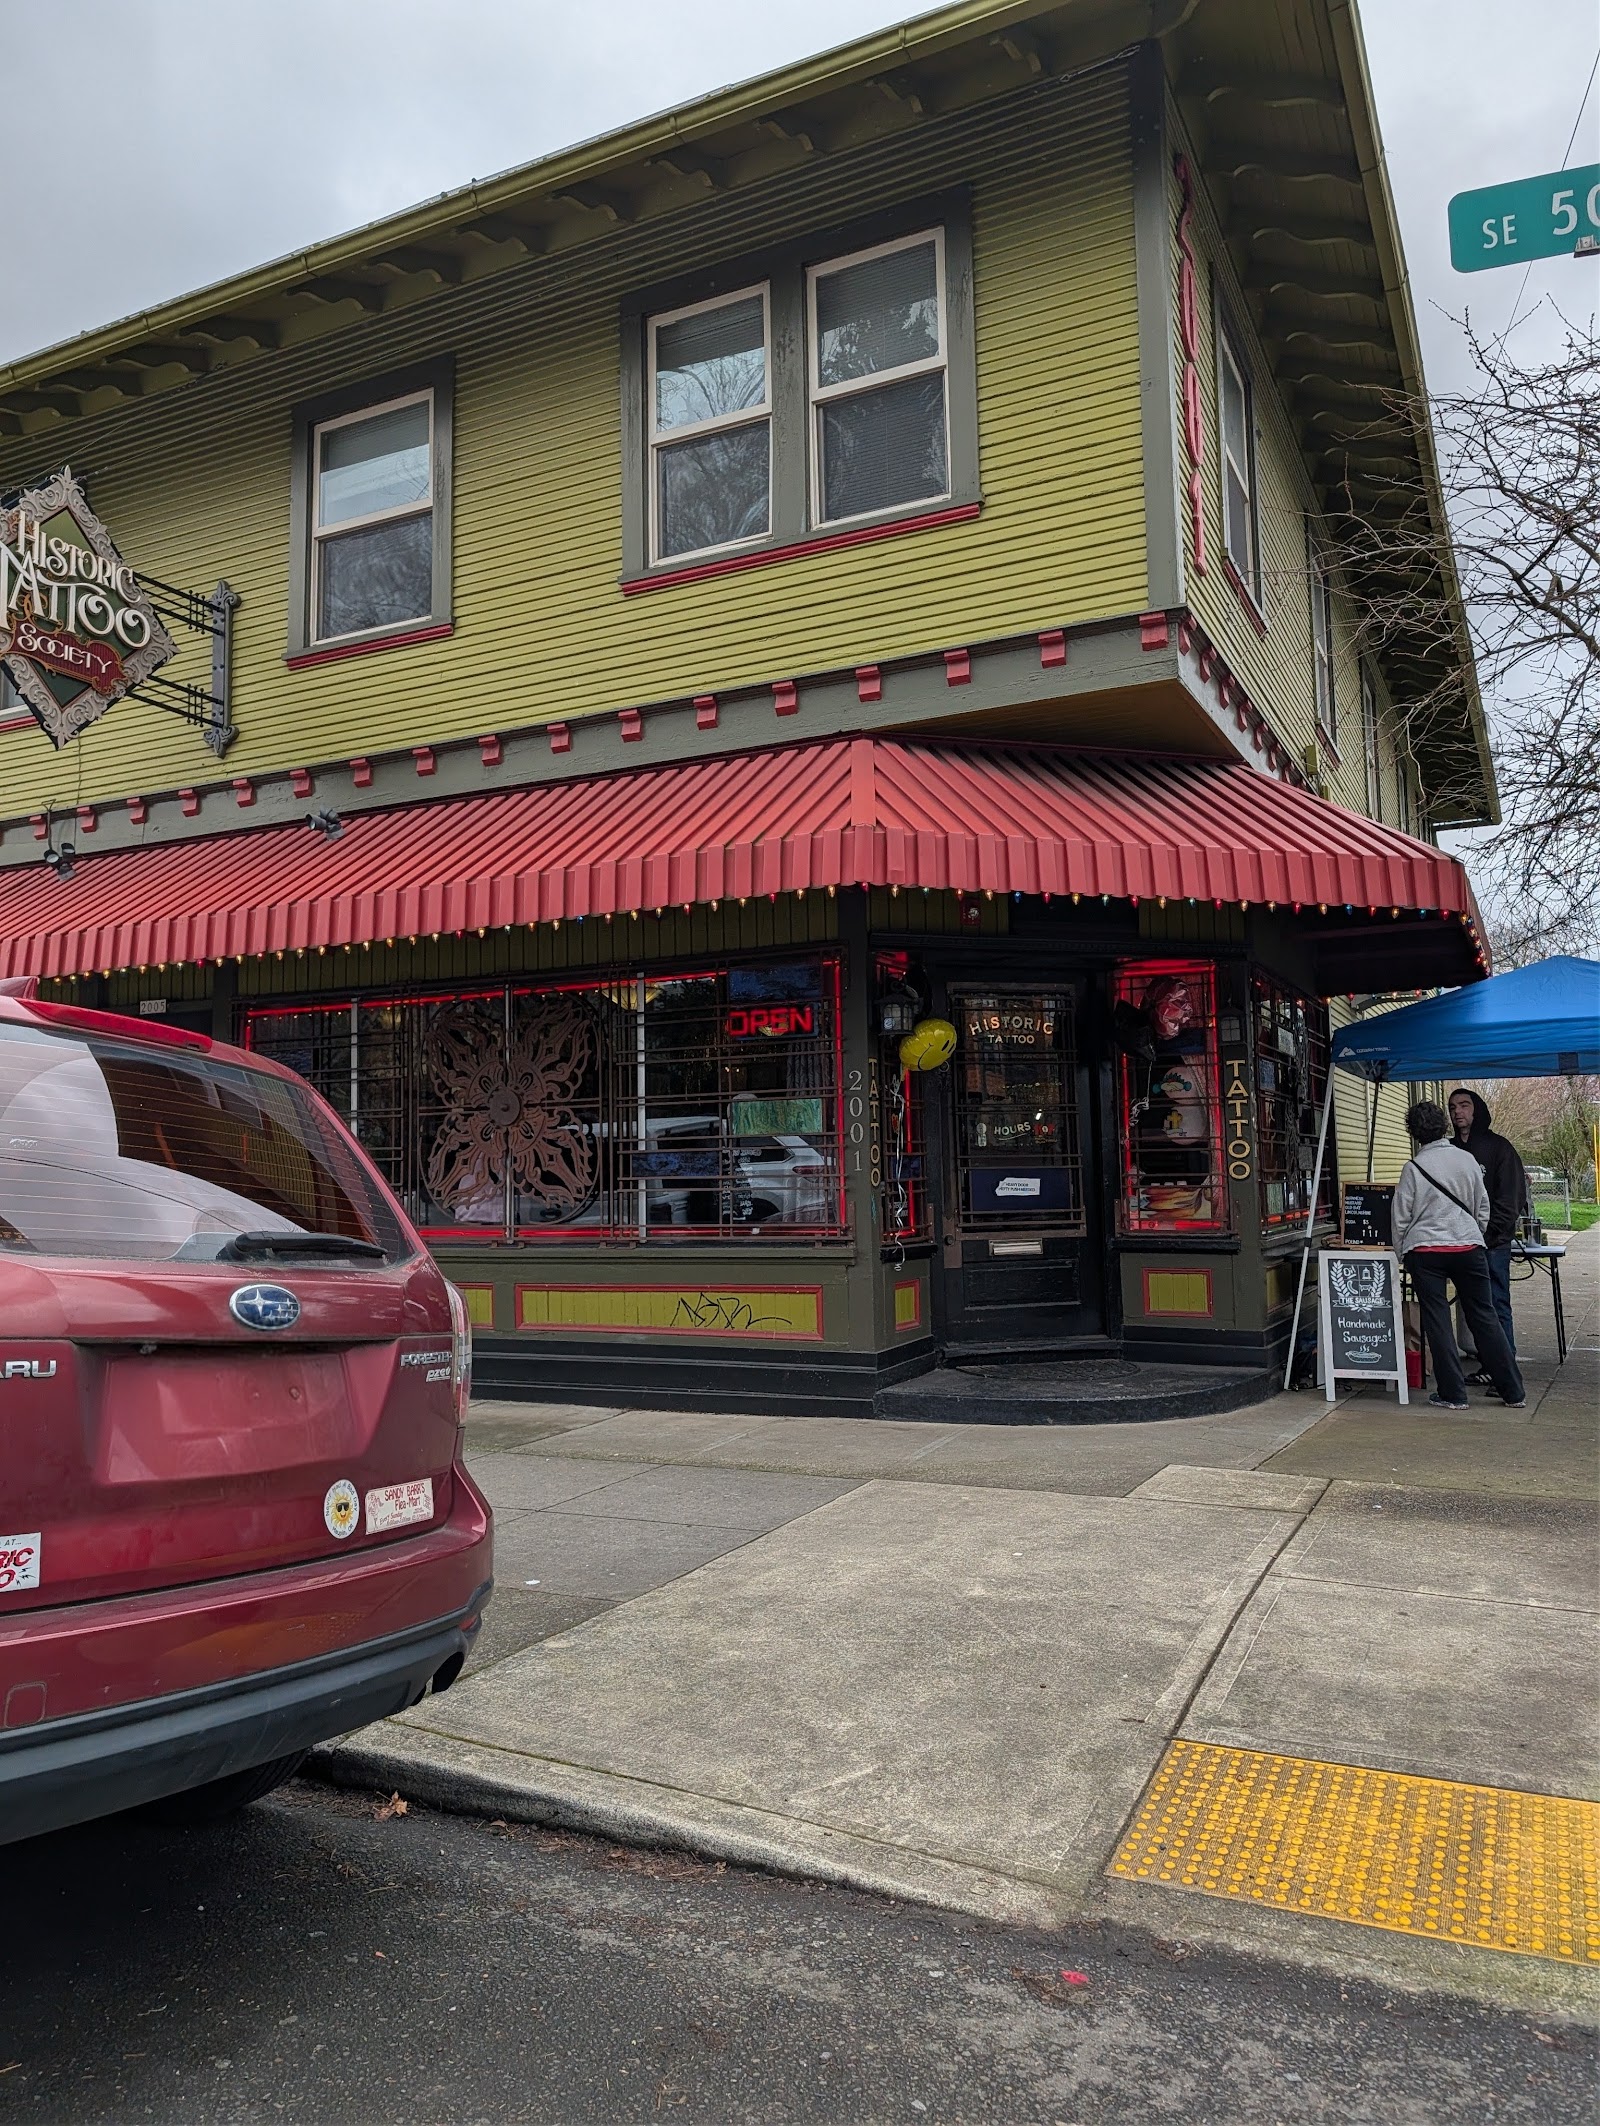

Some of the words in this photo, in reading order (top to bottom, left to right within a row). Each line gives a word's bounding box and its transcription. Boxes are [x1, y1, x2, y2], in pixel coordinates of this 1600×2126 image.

[1482, 214, 1517, 249] SE
[16, 510, 141, 603] HISTORIC
[17, 623, 113, 674] SOCIETY
[141, 1001, 165, 1013] 2005
[728, 1006, 812, 1037] OPEN
[969, 1016, 1054, 1036] HISTORIC
[988, 1034, 1035, 1044] TATTOO
[849, 1070, 864, 1172] 2001
[868, 1058, 881, 1187] TATTOO
[994, 1121, 1032, 1136] HOURS
[1226, 1059, 1251, 1180] TATTOO
[1355, 1297, 1384, 1305] SAUSAGE
[1338, 1317, 1386, 1329] Handmade
[1343, 1328, 1392, 1347] Sausages!
[0, 1360, 57, 1379] RU
[384, 1487, 405, 1502] SANDY
